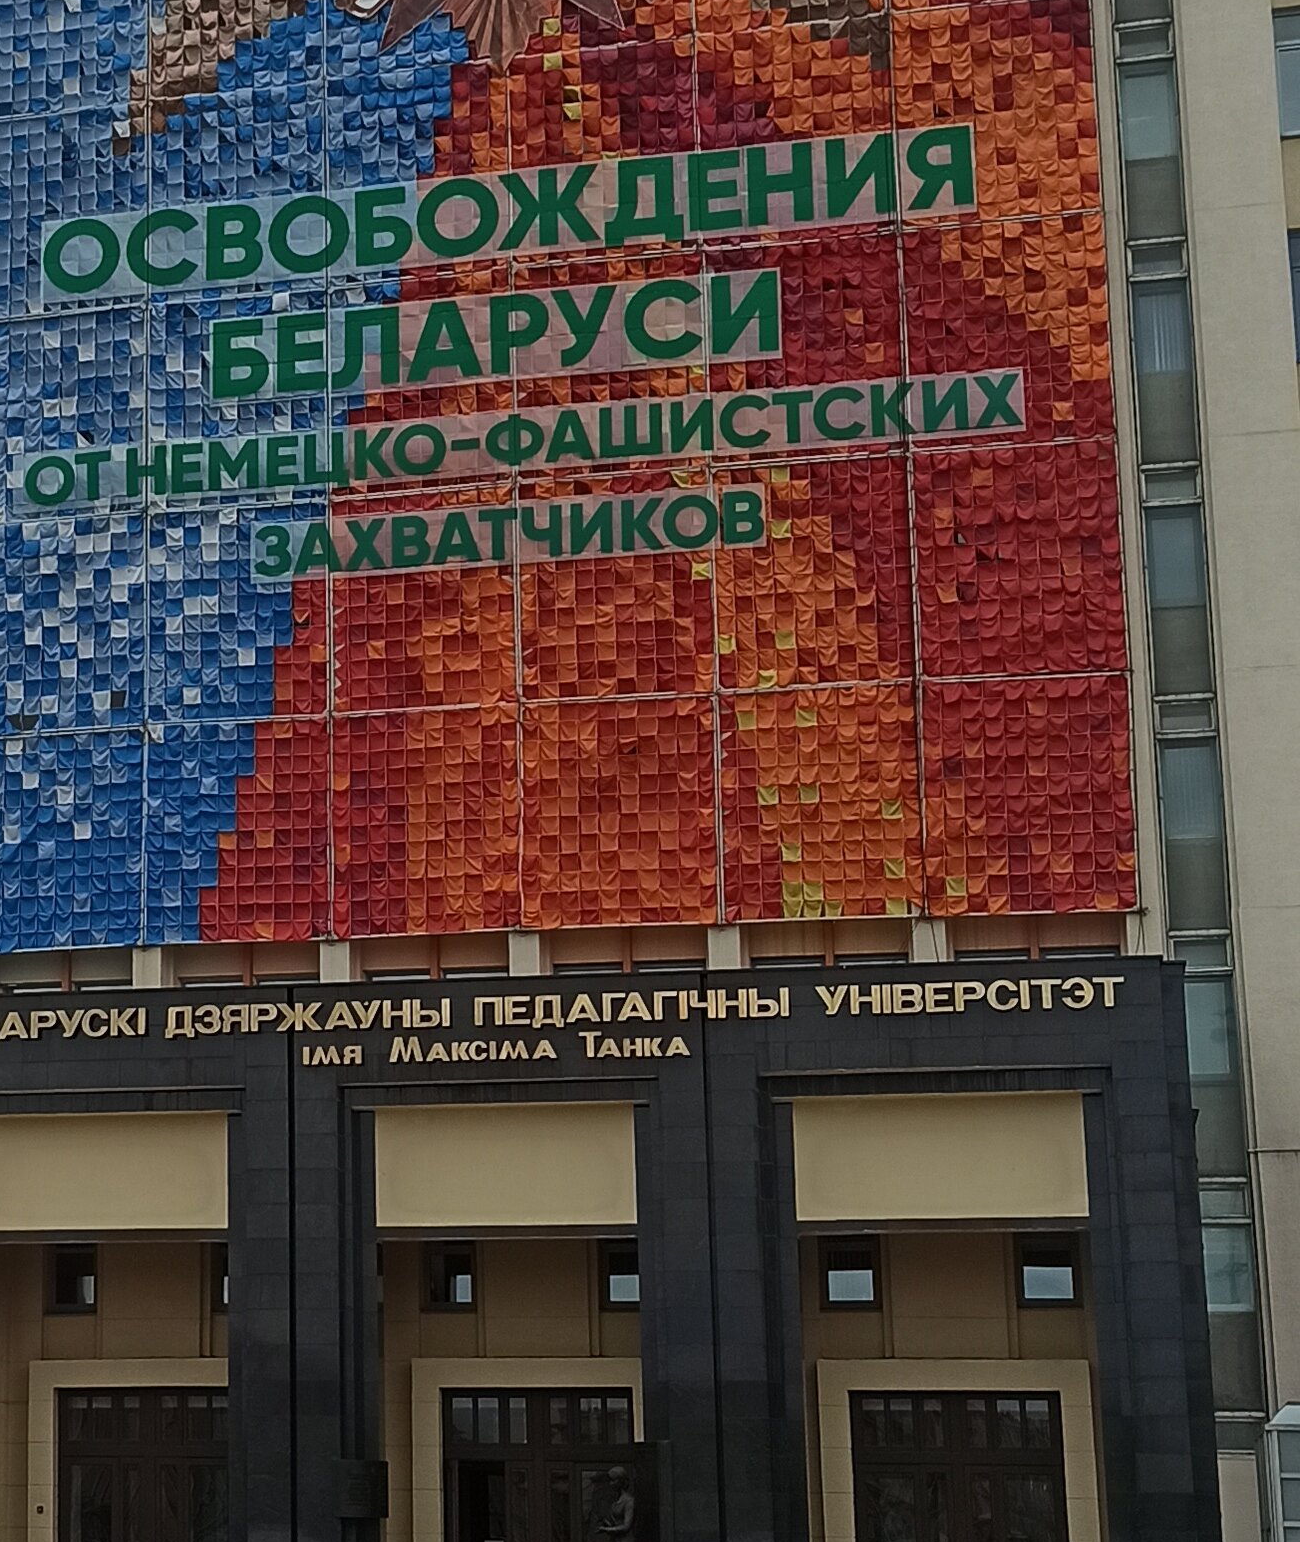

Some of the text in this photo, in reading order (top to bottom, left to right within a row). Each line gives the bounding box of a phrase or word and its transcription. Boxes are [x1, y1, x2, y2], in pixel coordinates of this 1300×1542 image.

[43, 125, 975, 293] ОСВОБОЖДЕНИЯ
[211, 271, 779, 400] БЕЛАРУСИ
[24, 373, 1024, 507] ОТ НЕМЕЦКО-ФАШИСТСКИХ
[254, 489, 765, 578] ЗАХВАТЧИКОВ
[474, 985, 791, 1029] ПЕДАГАГІЧНЫ
